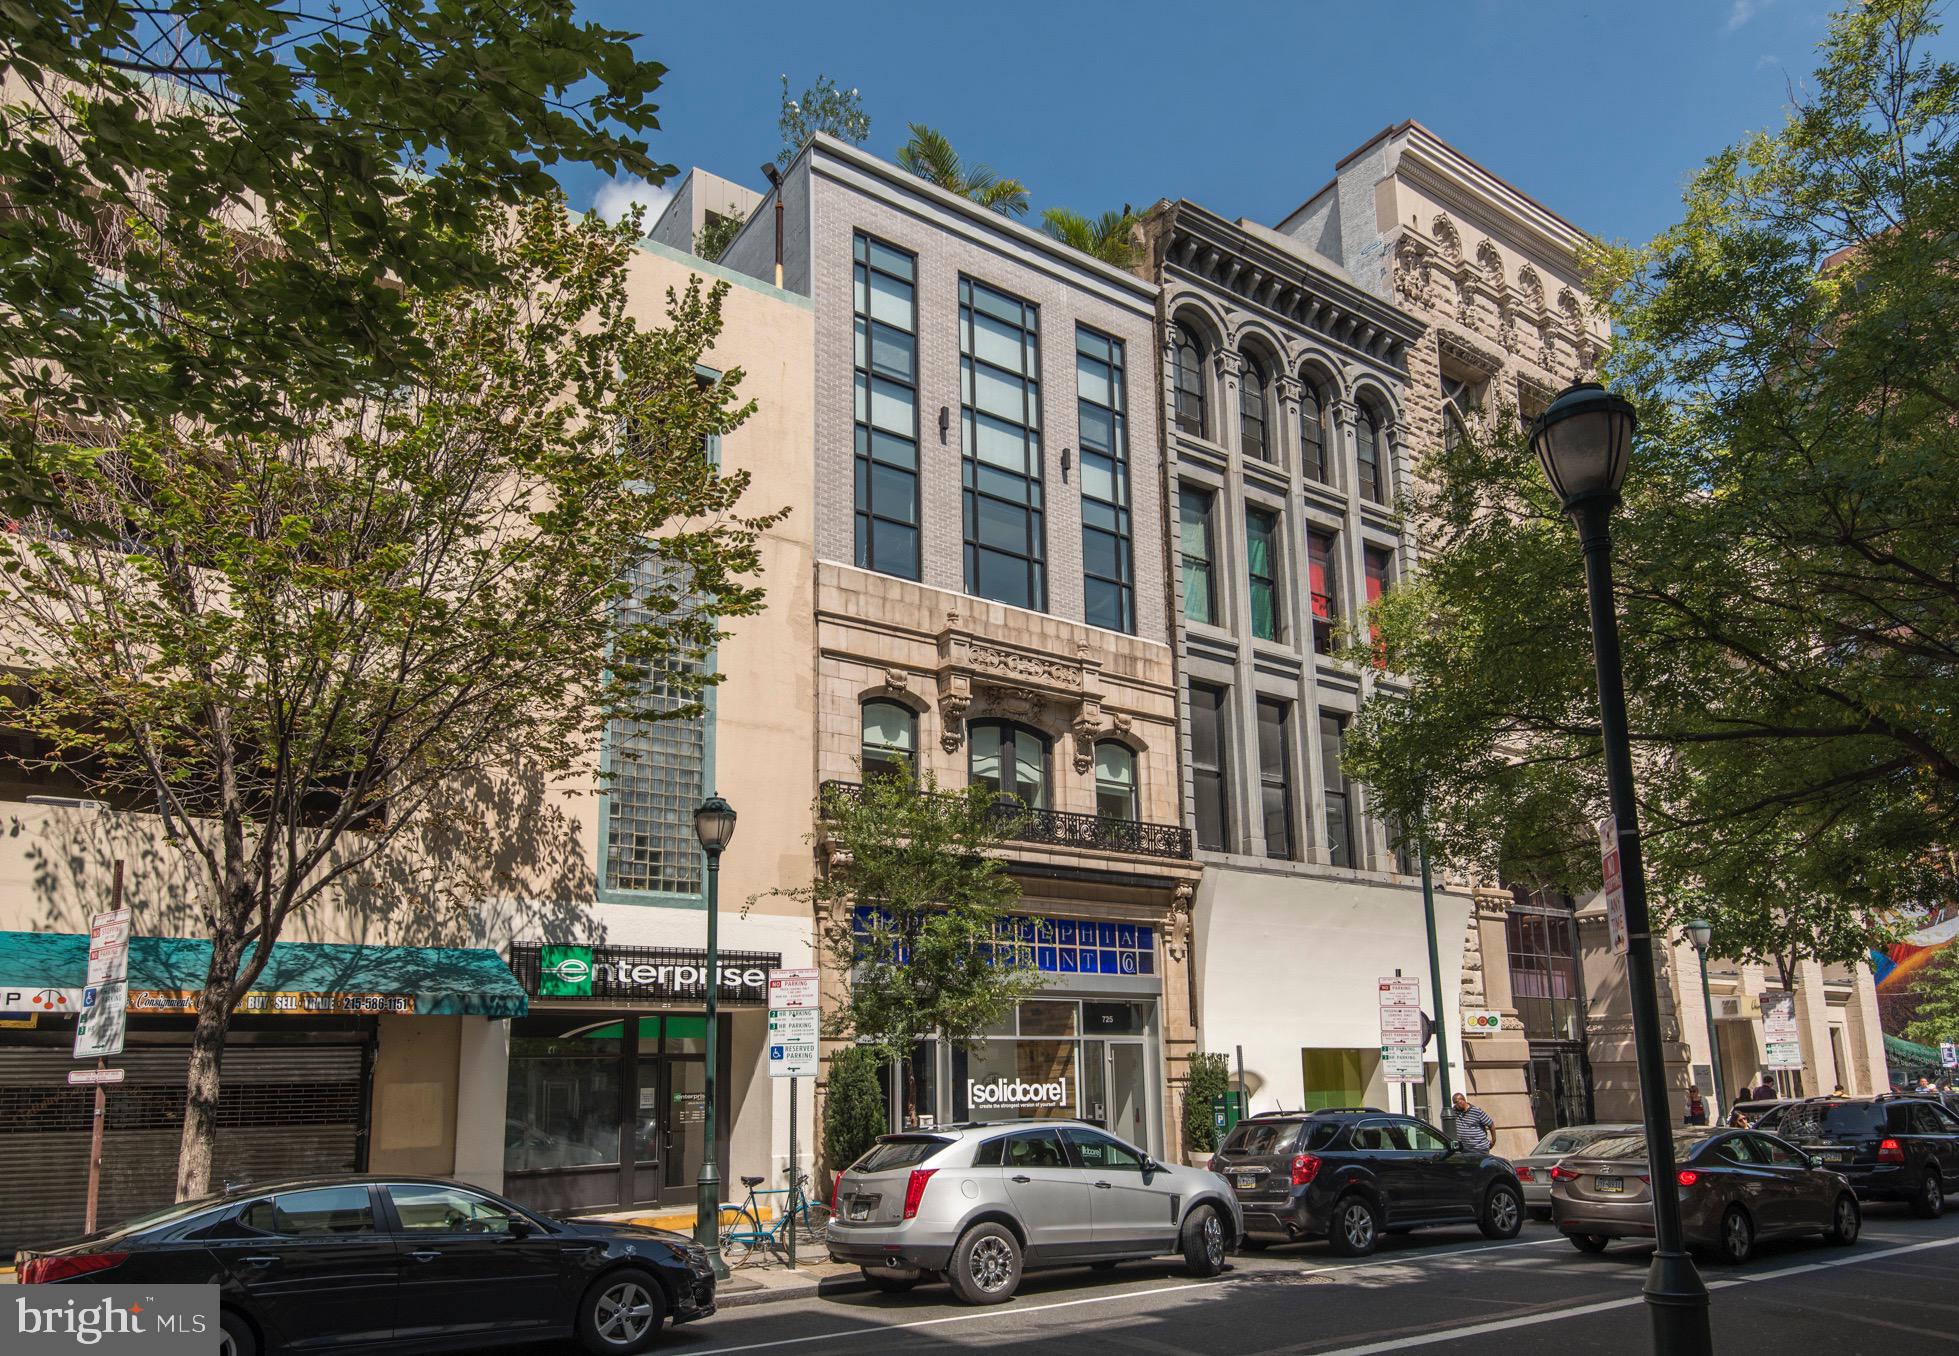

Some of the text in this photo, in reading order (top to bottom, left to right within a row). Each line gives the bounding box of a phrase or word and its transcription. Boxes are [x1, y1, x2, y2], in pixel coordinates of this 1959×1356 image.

[1610, 896, 1620, 912] ANY
[538, 958, 766, 991] enterprise
[136, 992, 189, 1009] Consignment
[247, 996, 269, 1010] BUY
[275, 996, 297, 1010] SELL
[304, 996, 335, 1010] TRADE
[343, 996, 408, 1010] 215-586-1151
[967, 1077, 1066, 1109] [solidcore]
